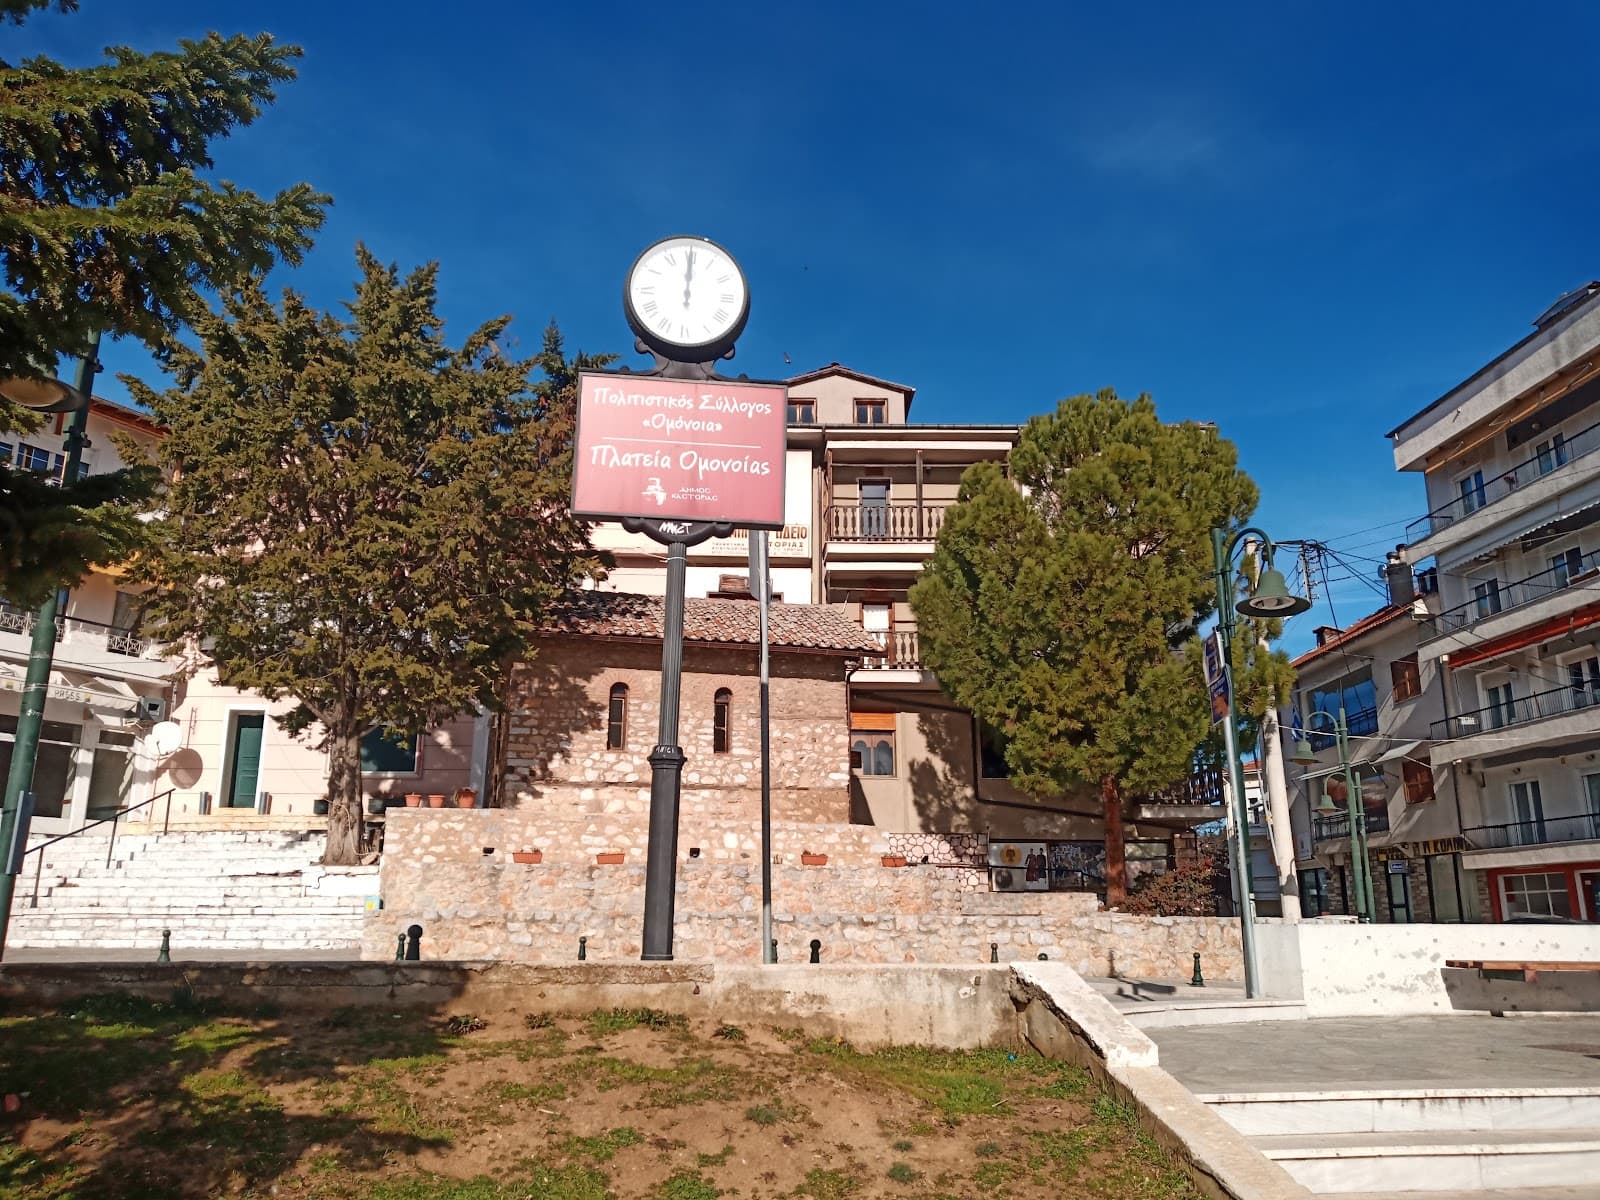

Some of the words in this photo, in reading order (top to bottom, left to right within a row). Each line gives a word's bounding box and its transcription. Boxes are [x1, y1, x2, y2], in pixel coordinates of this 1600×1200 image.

[593, 387, 693, 409] Πολιτιστικός
[699, 394, 772, 418] Σύλλογος
[643, 413, 723, 436] «Ομόνοια»
[591, 445, 671, 468] Πλατεία
[679, 451, 770, 480] Ομονοίας
